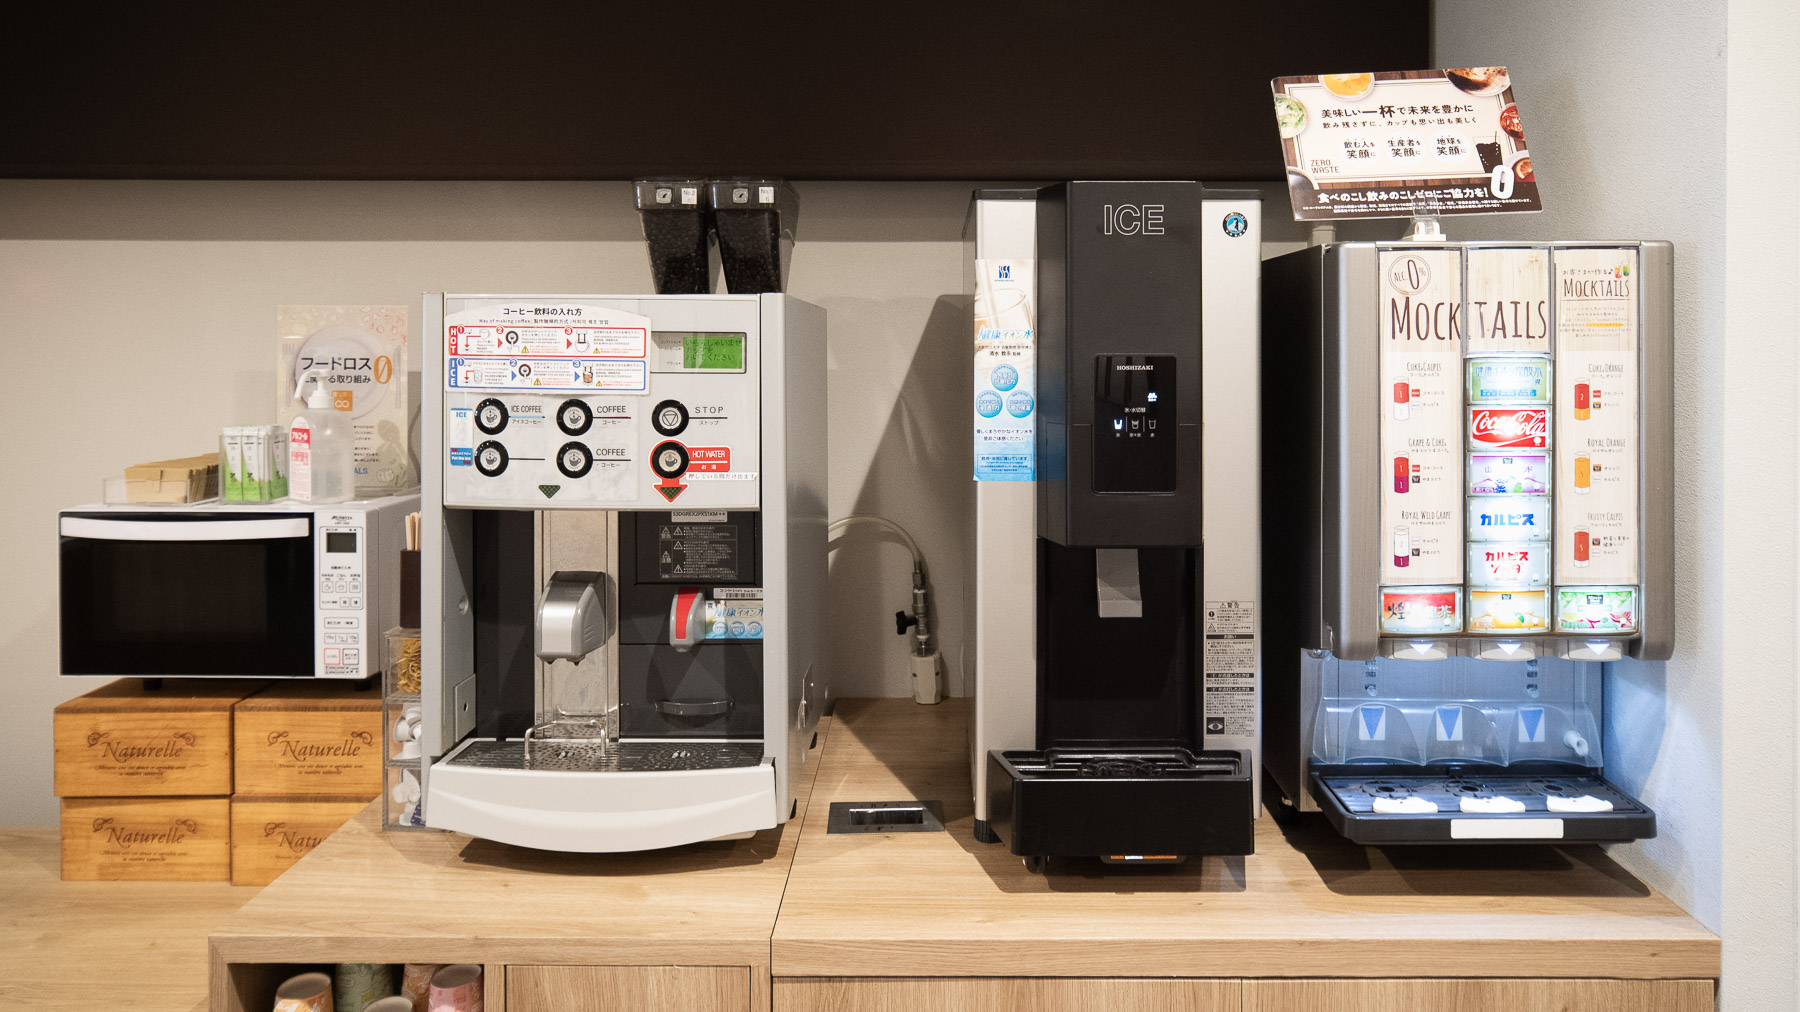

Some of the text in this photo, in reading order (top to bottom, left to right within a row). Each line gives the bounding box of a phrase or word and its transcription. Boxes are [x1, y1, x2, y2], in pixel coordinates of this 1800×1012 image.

[1321, 105, 1473, 118] 美味しい一杯で未来を豊かに
[1312, 166, 1340, 174] WASTE
[1104, 204, 1164, 235] ICE
[1564, 278, 1630, 297] MOCKTAILS
[503, 308, 582, 316] コーヒー飲料の入れ方
[301, 357, 372, 370] フードロス
[1481, 514, 1534, 526] カルピス
[1486, 552, 1528, 561] カルピス
[102, 740, 183, 763] Naturelle
[280, 740, 361, 762] Naturelle
[105, 827, 185, 849] Naturelle
